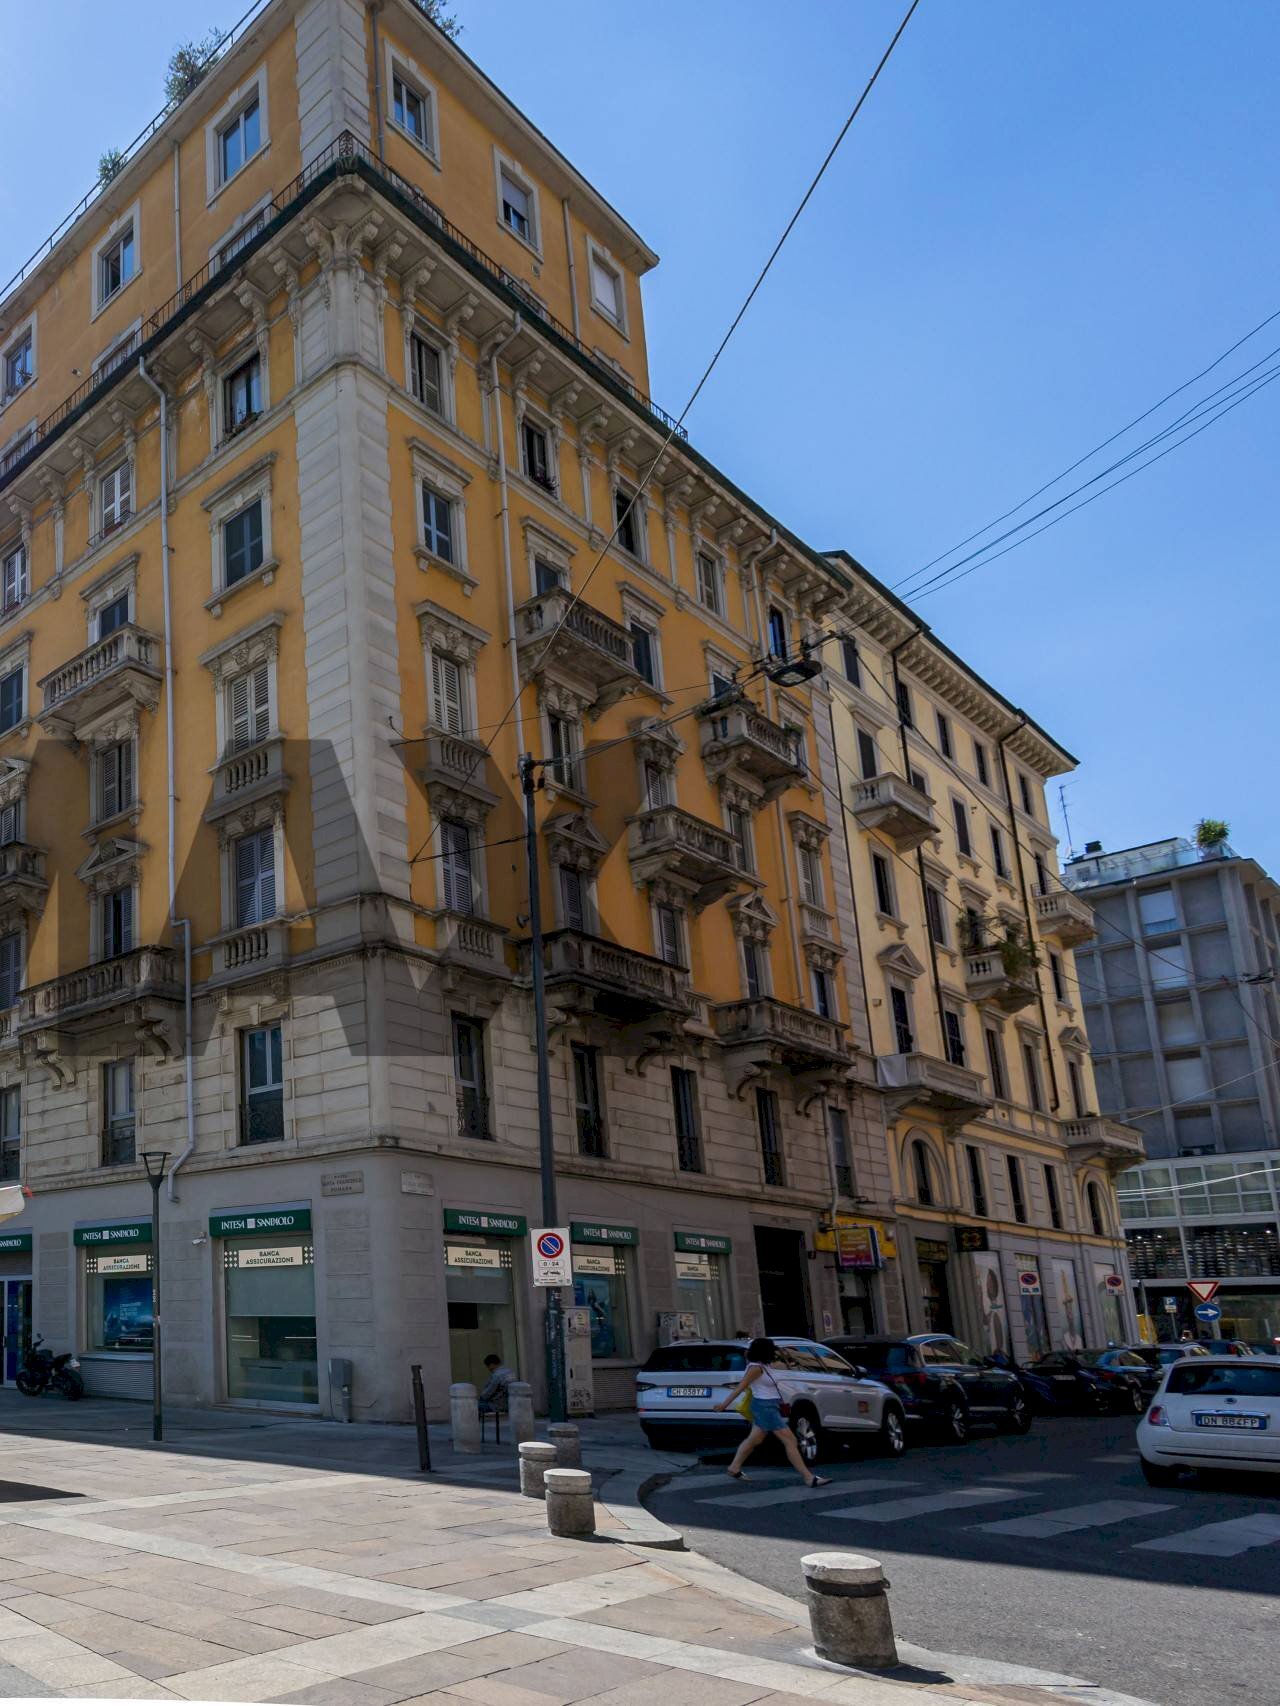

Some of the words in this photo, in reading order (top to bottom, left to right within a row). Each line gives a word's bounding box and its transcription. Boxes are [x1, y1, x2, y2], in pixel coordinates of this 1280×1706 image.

[221, 1219, 245, 1230] INTESA
[256, 1215, 294, 1227] SANPAOLO
[458, 1215, 480, 1226] INTESA
[489, 1217, 518, 1230] SANPAOLO
[82, 1230, 102, 1240] INTESA
[109, 1228, 139, 1239] SANPAOLO
[583, 1228, 601, 1237] INTESA
[245, 1256, 294, 1265] ASSICURAZIONE
[454, 1257, 493, 1265] ASSICURAZIONE
